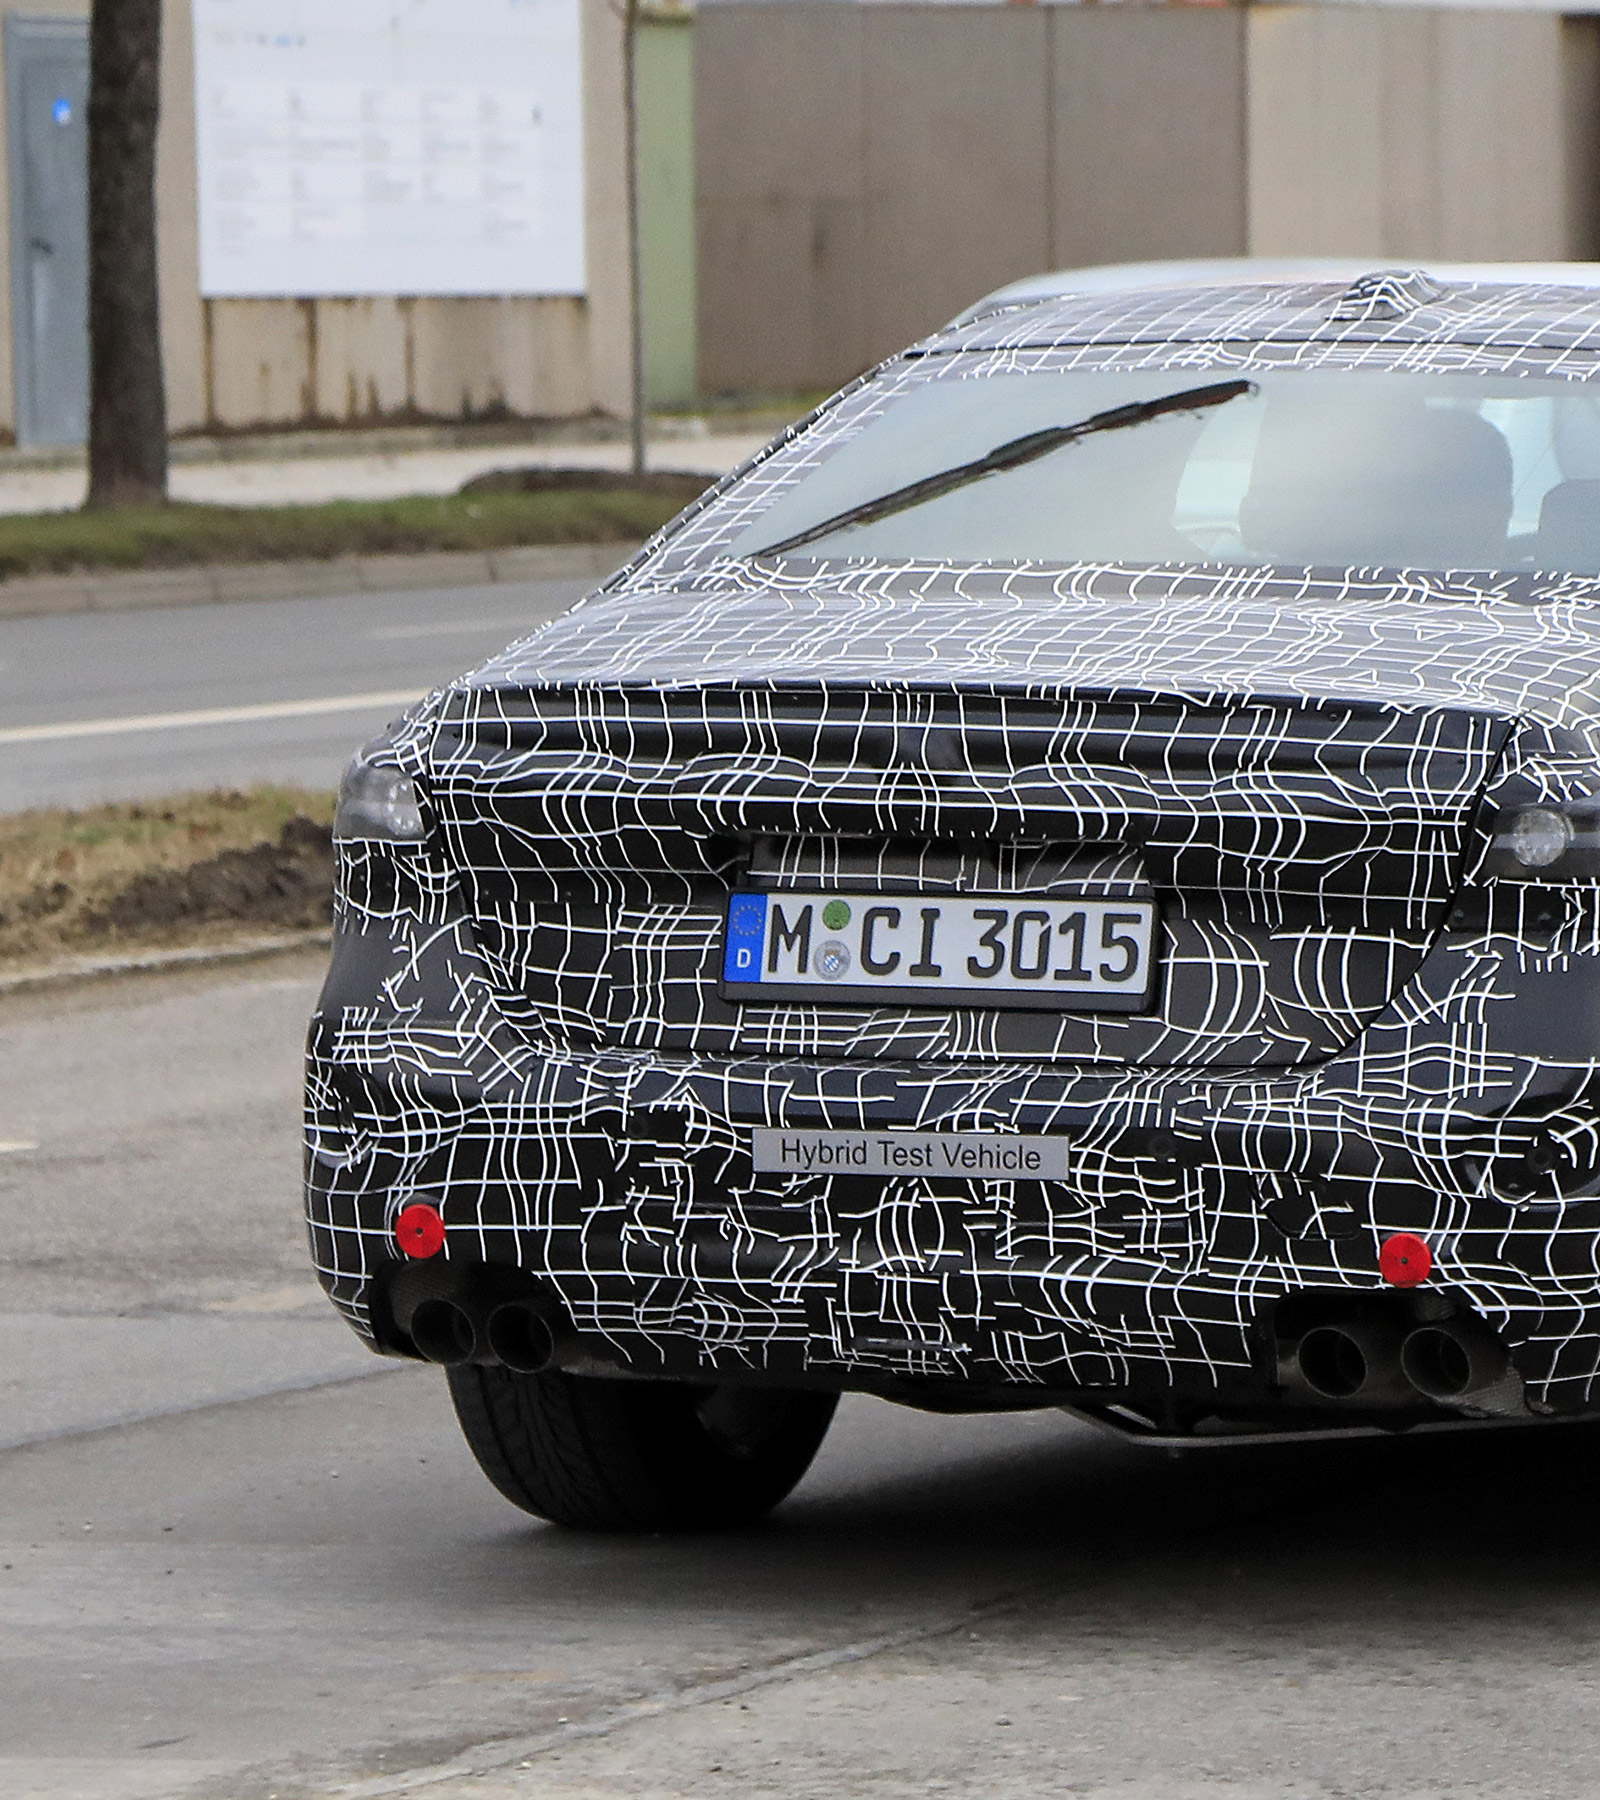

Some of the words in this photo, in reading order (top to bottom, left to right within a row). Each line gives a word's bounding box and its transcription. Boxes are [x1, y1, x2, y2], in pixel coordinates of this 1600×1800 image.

[736, 949, 751, 969] D
[768, 904, 813, 974] M
[861, 907, 941, 977] CI
[967, 910, 1142, 982] 3015
[780, 1138, 868, 1169] Hybrid
[877, 1140, 932, 1167] Test
[941, 1142, 1041, 1170] Vehicle
